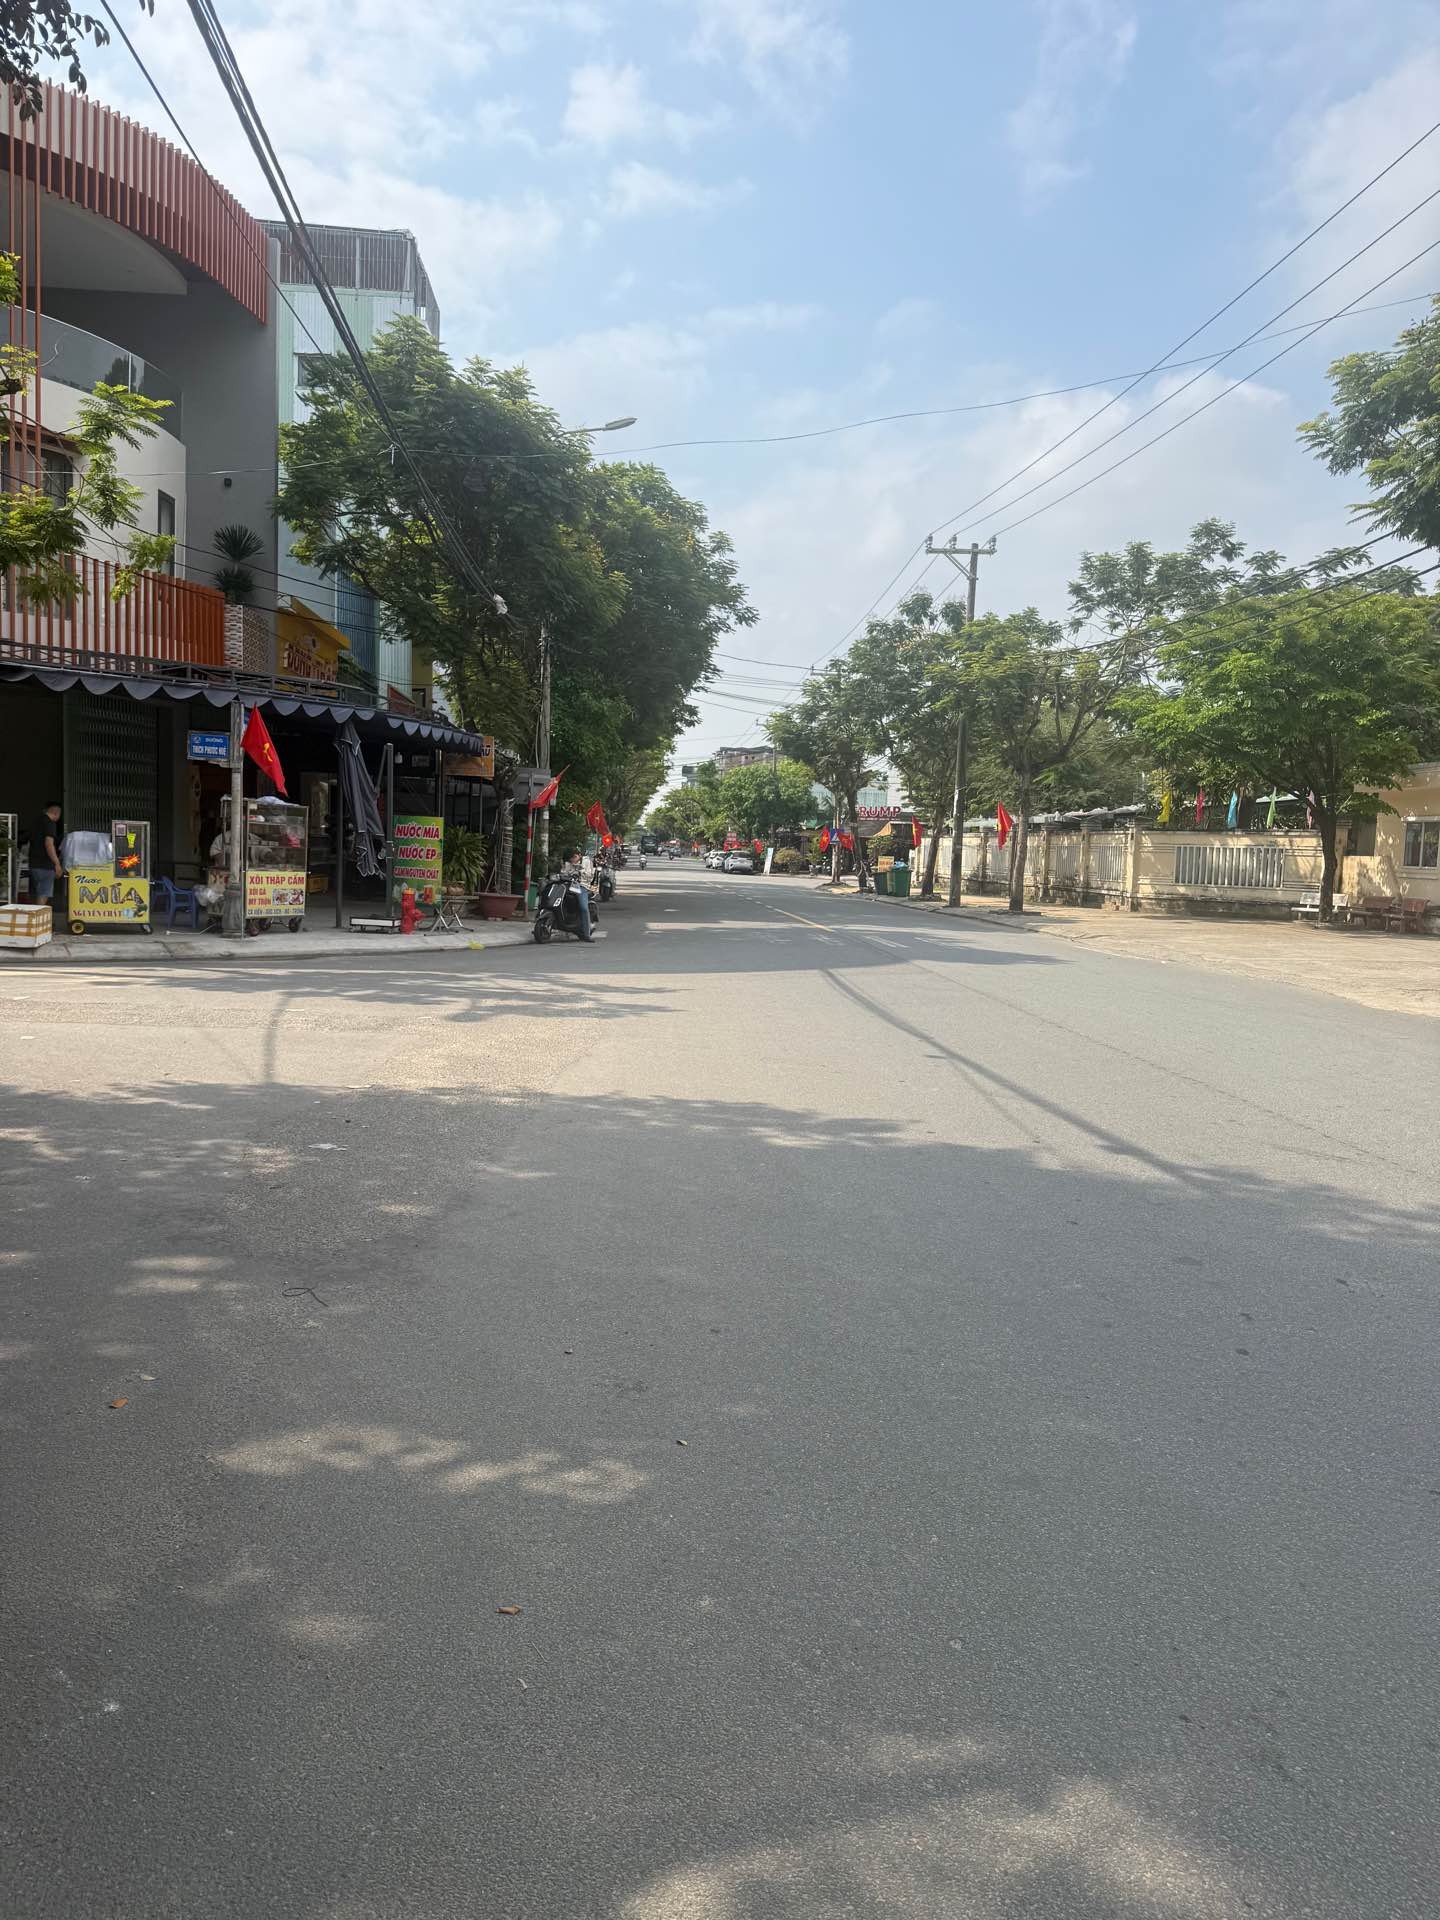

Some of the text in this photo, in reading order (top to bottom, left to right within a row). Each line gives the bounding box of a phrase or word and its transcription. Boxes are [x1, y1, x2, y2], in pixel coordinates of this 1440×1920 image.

[395, 823, 440, 840] NƯỚC MÍA
[398, 845, 424, 860] NƯỚC
[79, 882, 145, 905] MÍA
